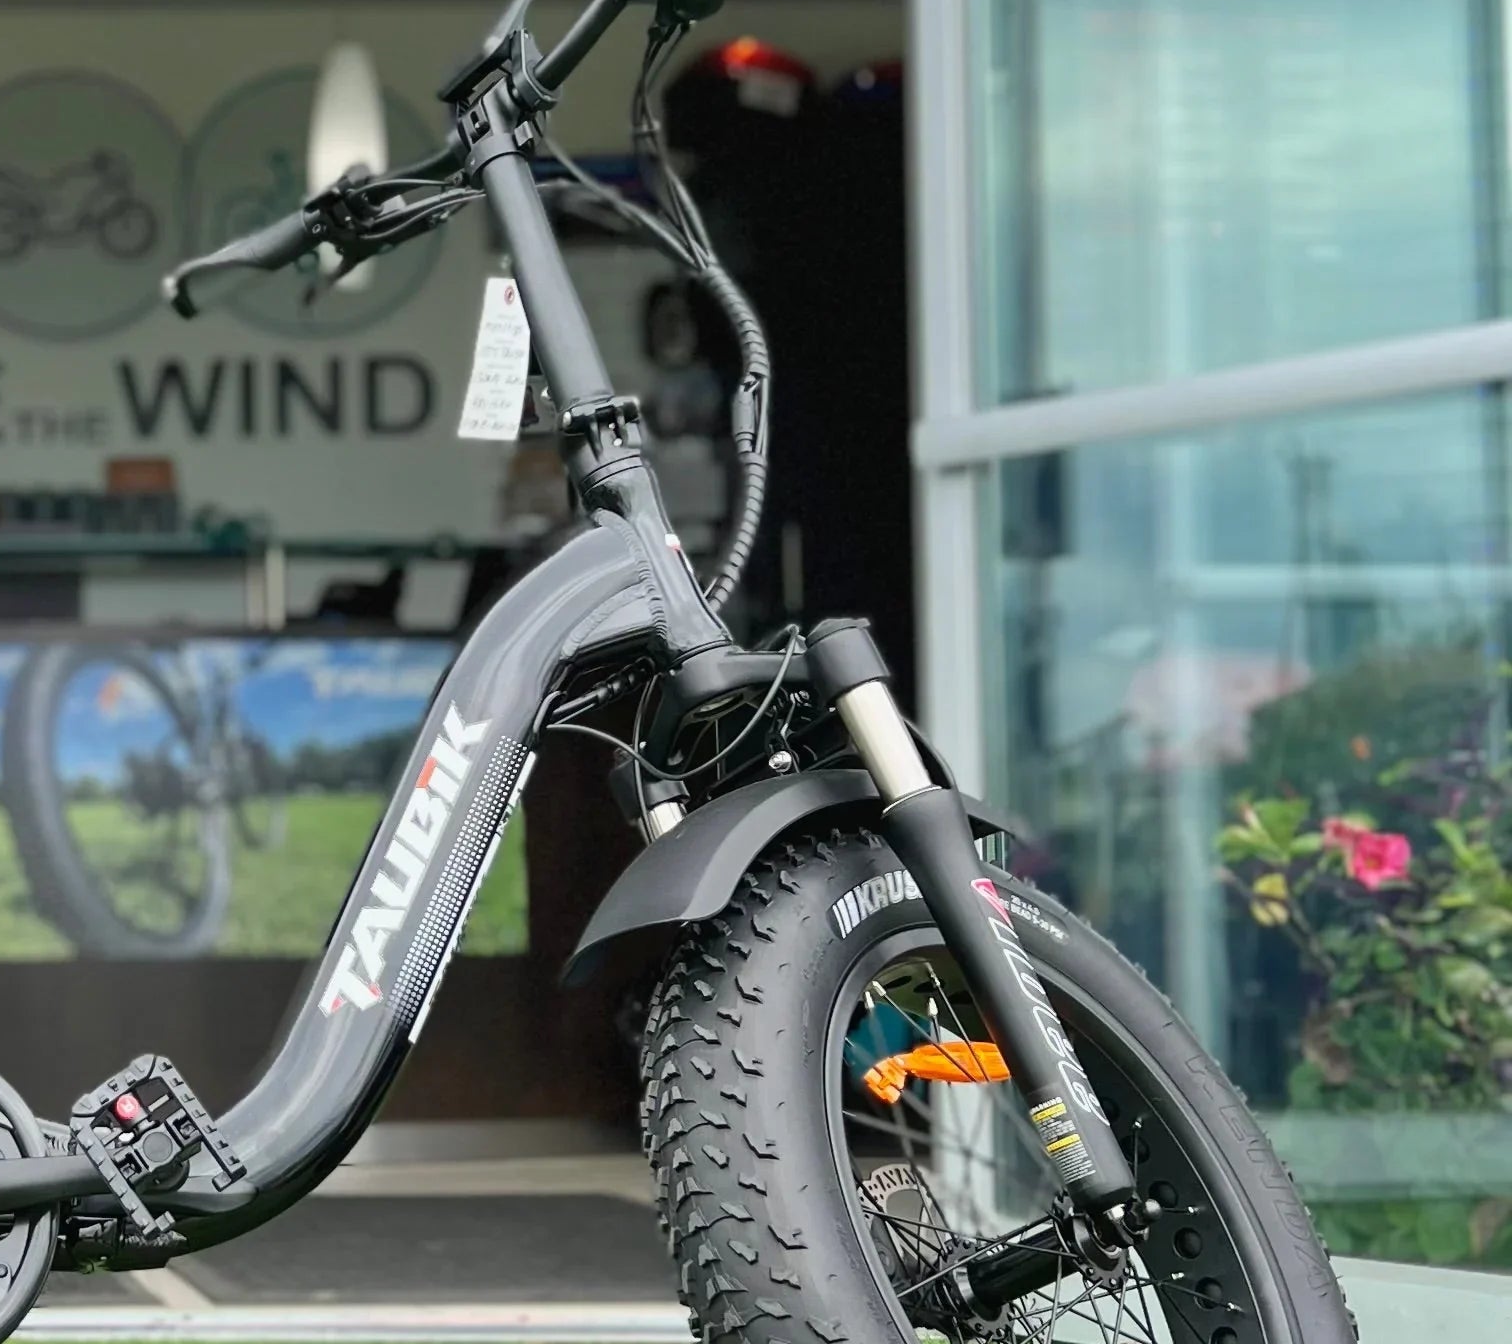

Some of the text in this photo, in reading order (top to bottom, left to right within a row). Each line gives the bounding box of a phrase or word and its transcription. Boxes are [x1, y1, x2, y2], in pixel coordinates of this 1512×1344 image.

[13, 409, 106, 446] THE
[118, 356, 436, 440] WIND
[318, 700, 492, 1017] TAUBIK
[1186, 1055, 1331, 1291] KENDA
